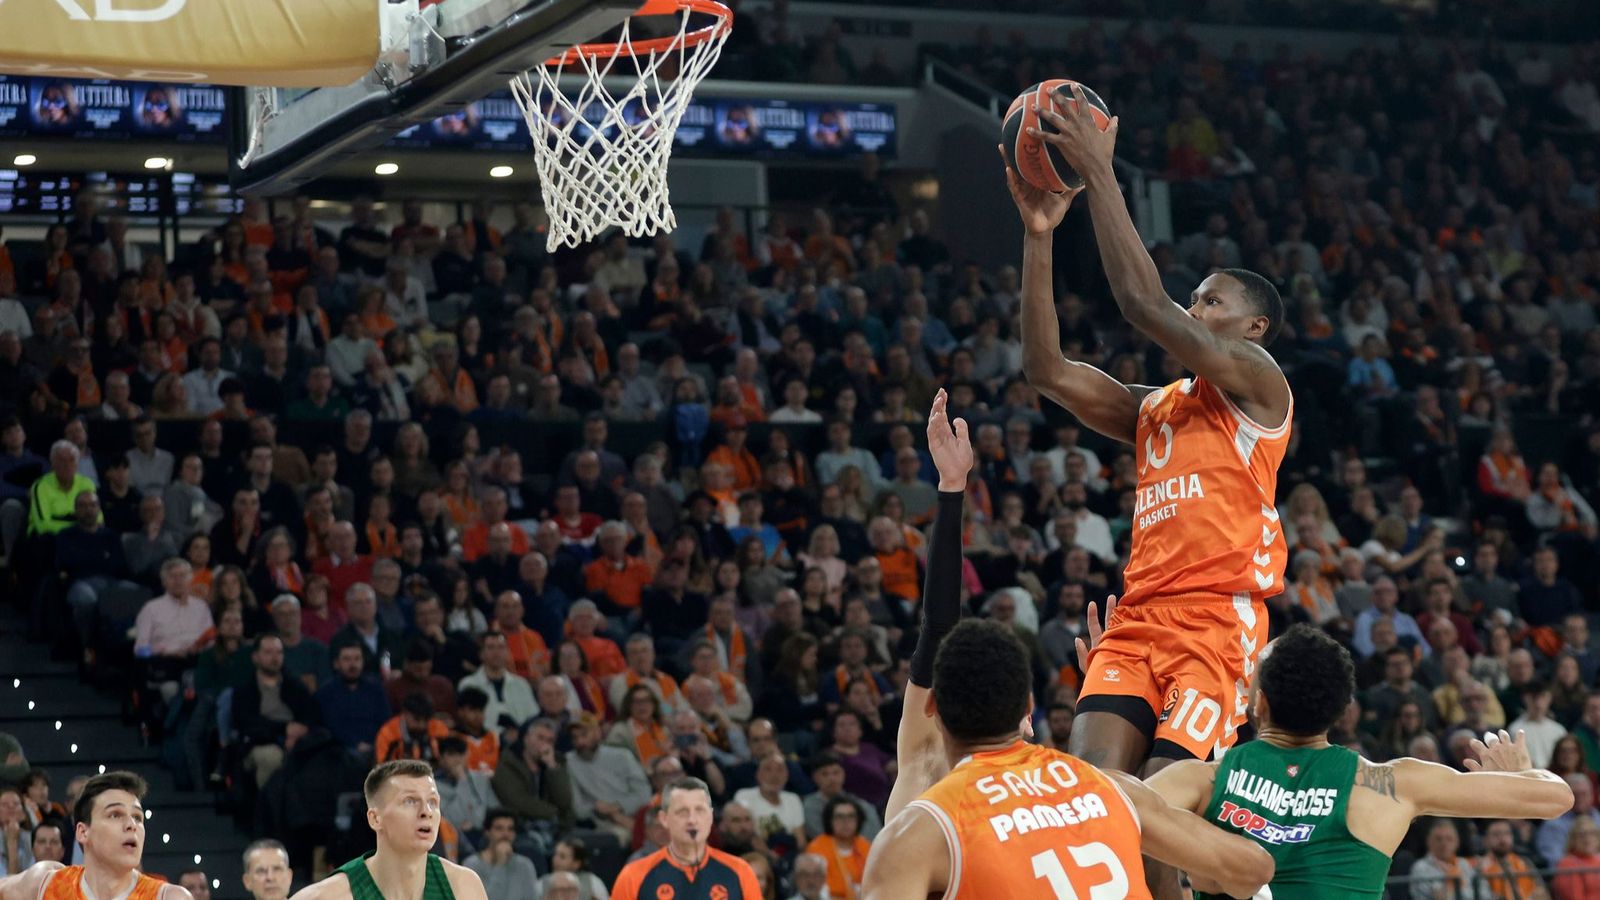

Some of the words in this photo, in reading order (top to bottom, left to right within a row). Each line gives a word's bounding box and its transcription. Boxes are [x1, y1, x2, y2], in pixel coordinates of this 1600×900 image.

[1133, 473, 1204, 520] ALENCIA
[1139, 503, 1178, 529] BASKET
[1170, 687, 1222, 742] 10
[975, 759, 1079, 805] SAKO
[1224, 768, 1338, 817] WILLIAMS-GOSS
[988, 792, 1109, 842] PAMESA
